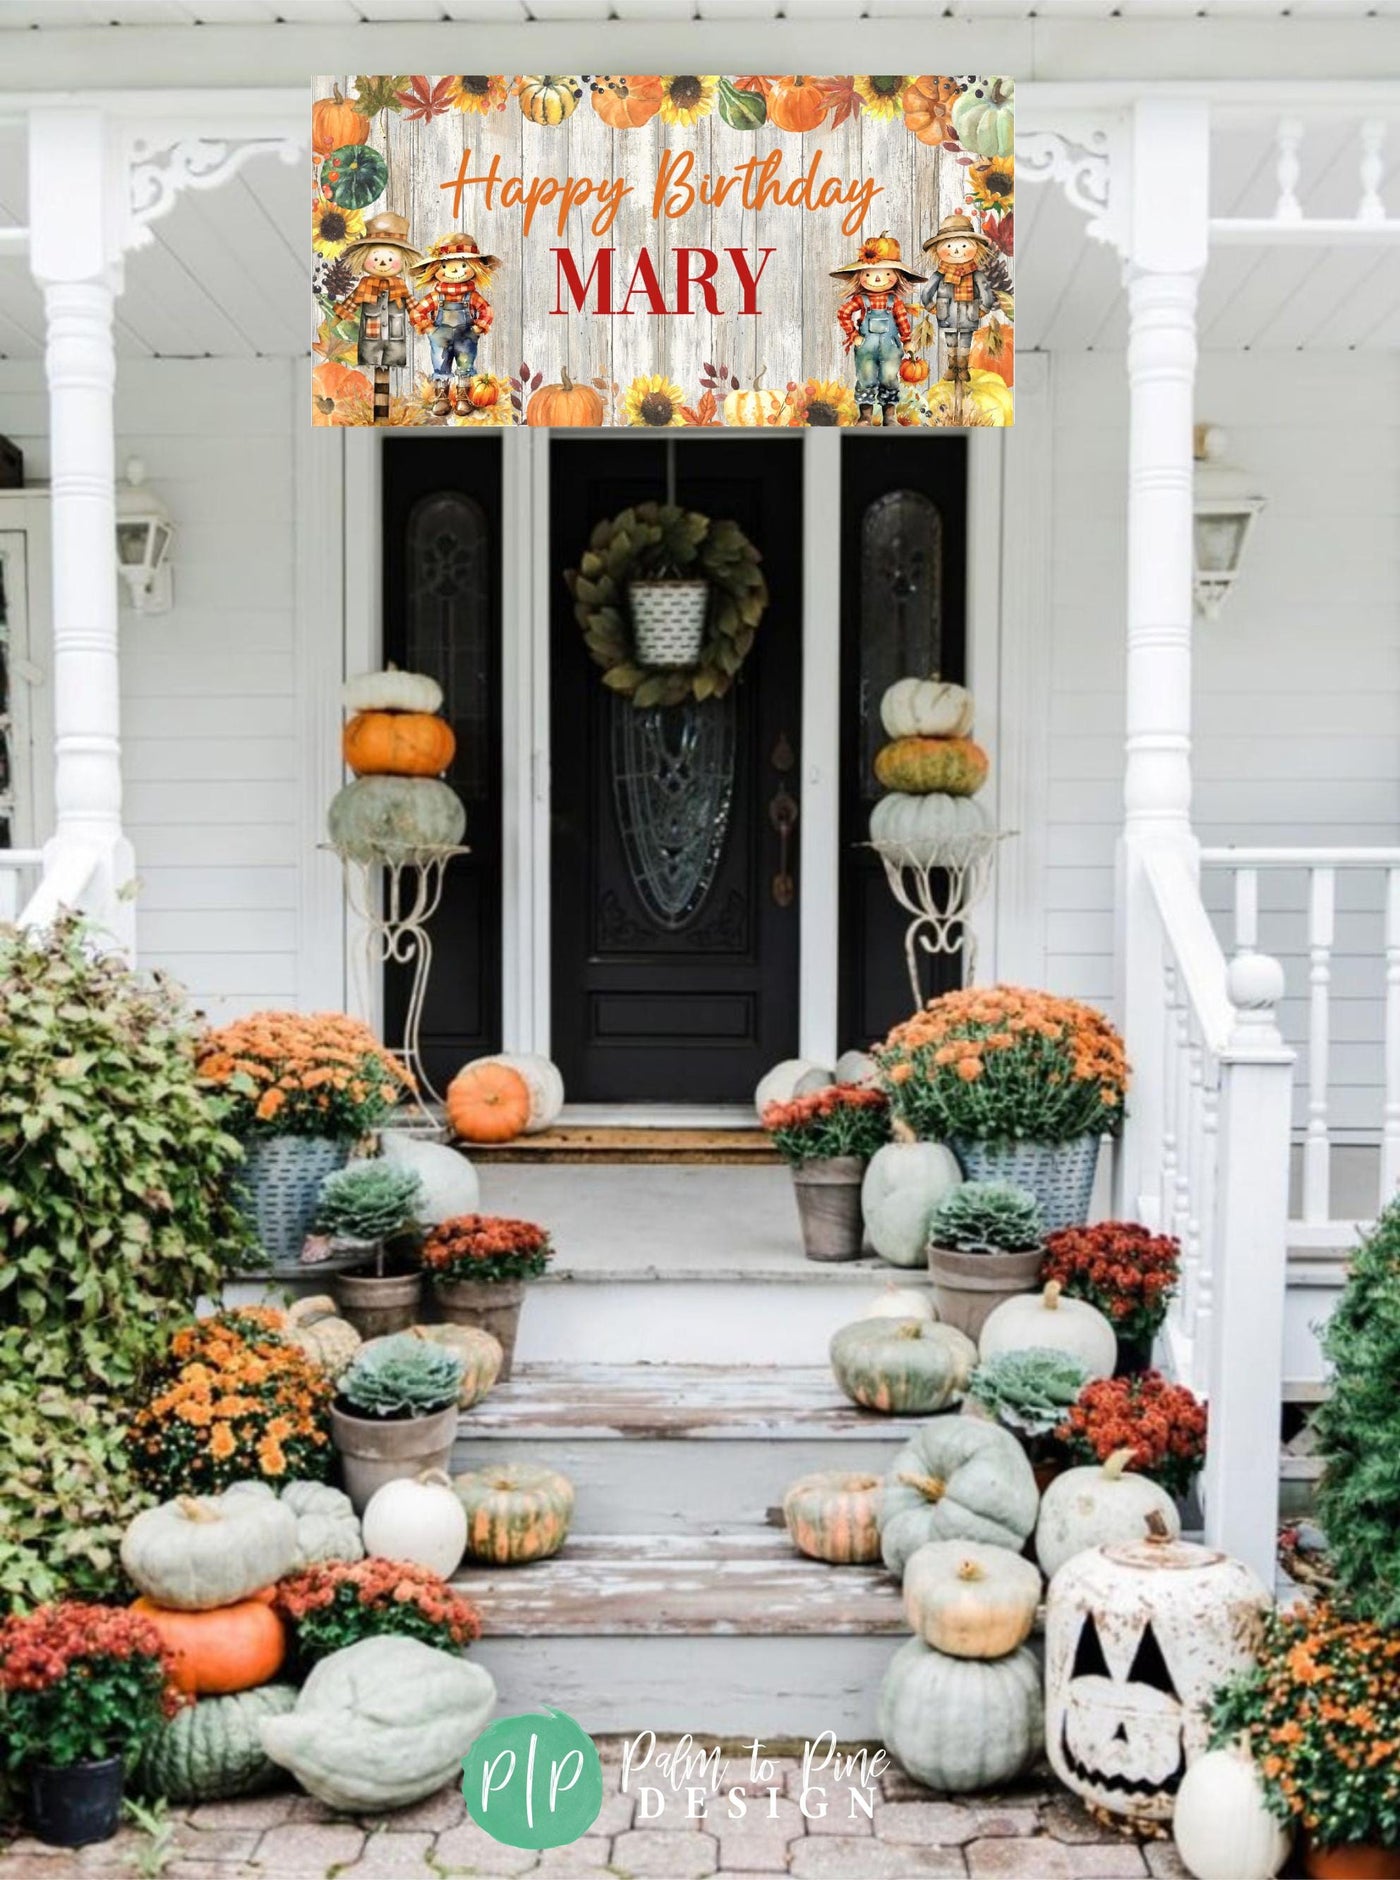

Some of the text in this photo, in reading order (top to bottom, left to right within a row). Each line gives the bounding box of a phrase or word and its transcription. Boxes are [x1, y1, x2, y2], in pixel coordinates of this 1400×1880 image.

[440, 148, 884, 238] Happy Birthday
[550, 247, 776, 315] MARY
